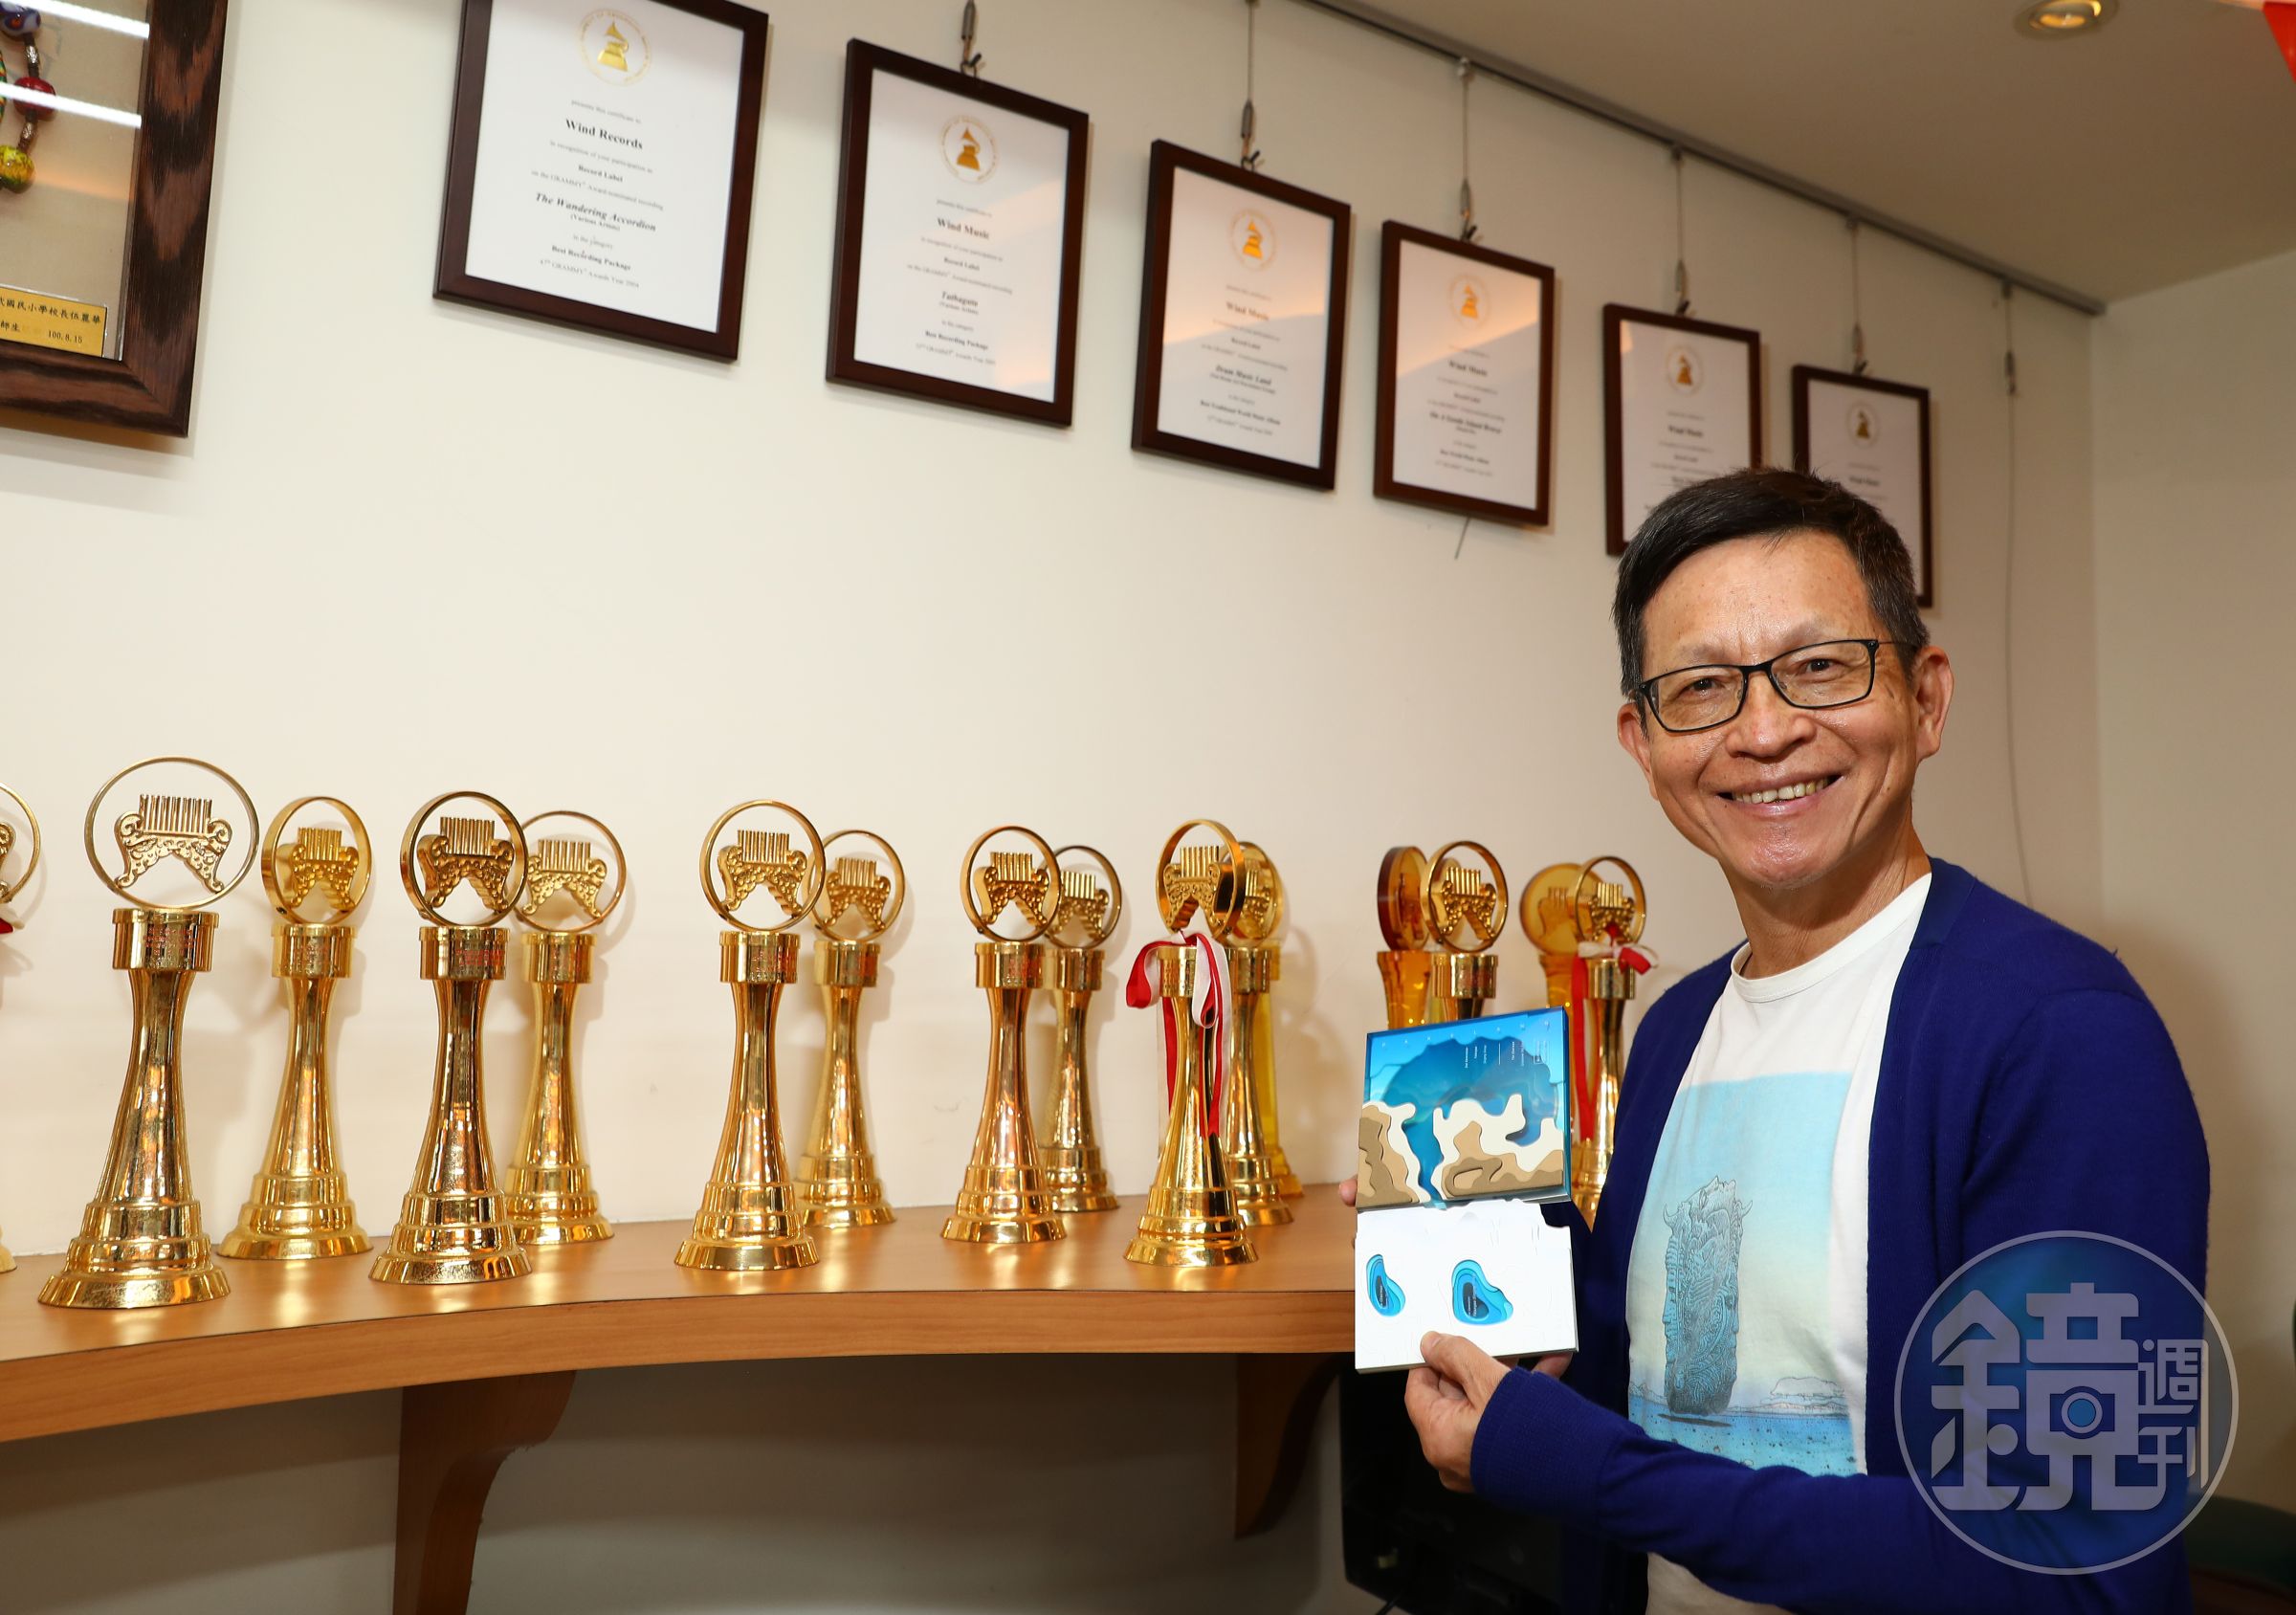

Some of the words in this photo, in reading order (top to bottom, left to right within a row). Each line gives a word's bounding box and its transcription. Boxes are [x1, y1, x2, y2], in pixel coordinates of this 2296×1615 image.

[565, 118, 596, 137] Wind
[599, 128, 643, 149] Records
[578, 164, 603, 177] Record
[604, 170, 624, 182] Label
[535, 191, 554, 204] The
[556, 197, 608, 221] Wandering
[610, 212, 656, 232] Accordion
[937, 217, 962, 232] Wind
[964, 224, 990, 240] Music
